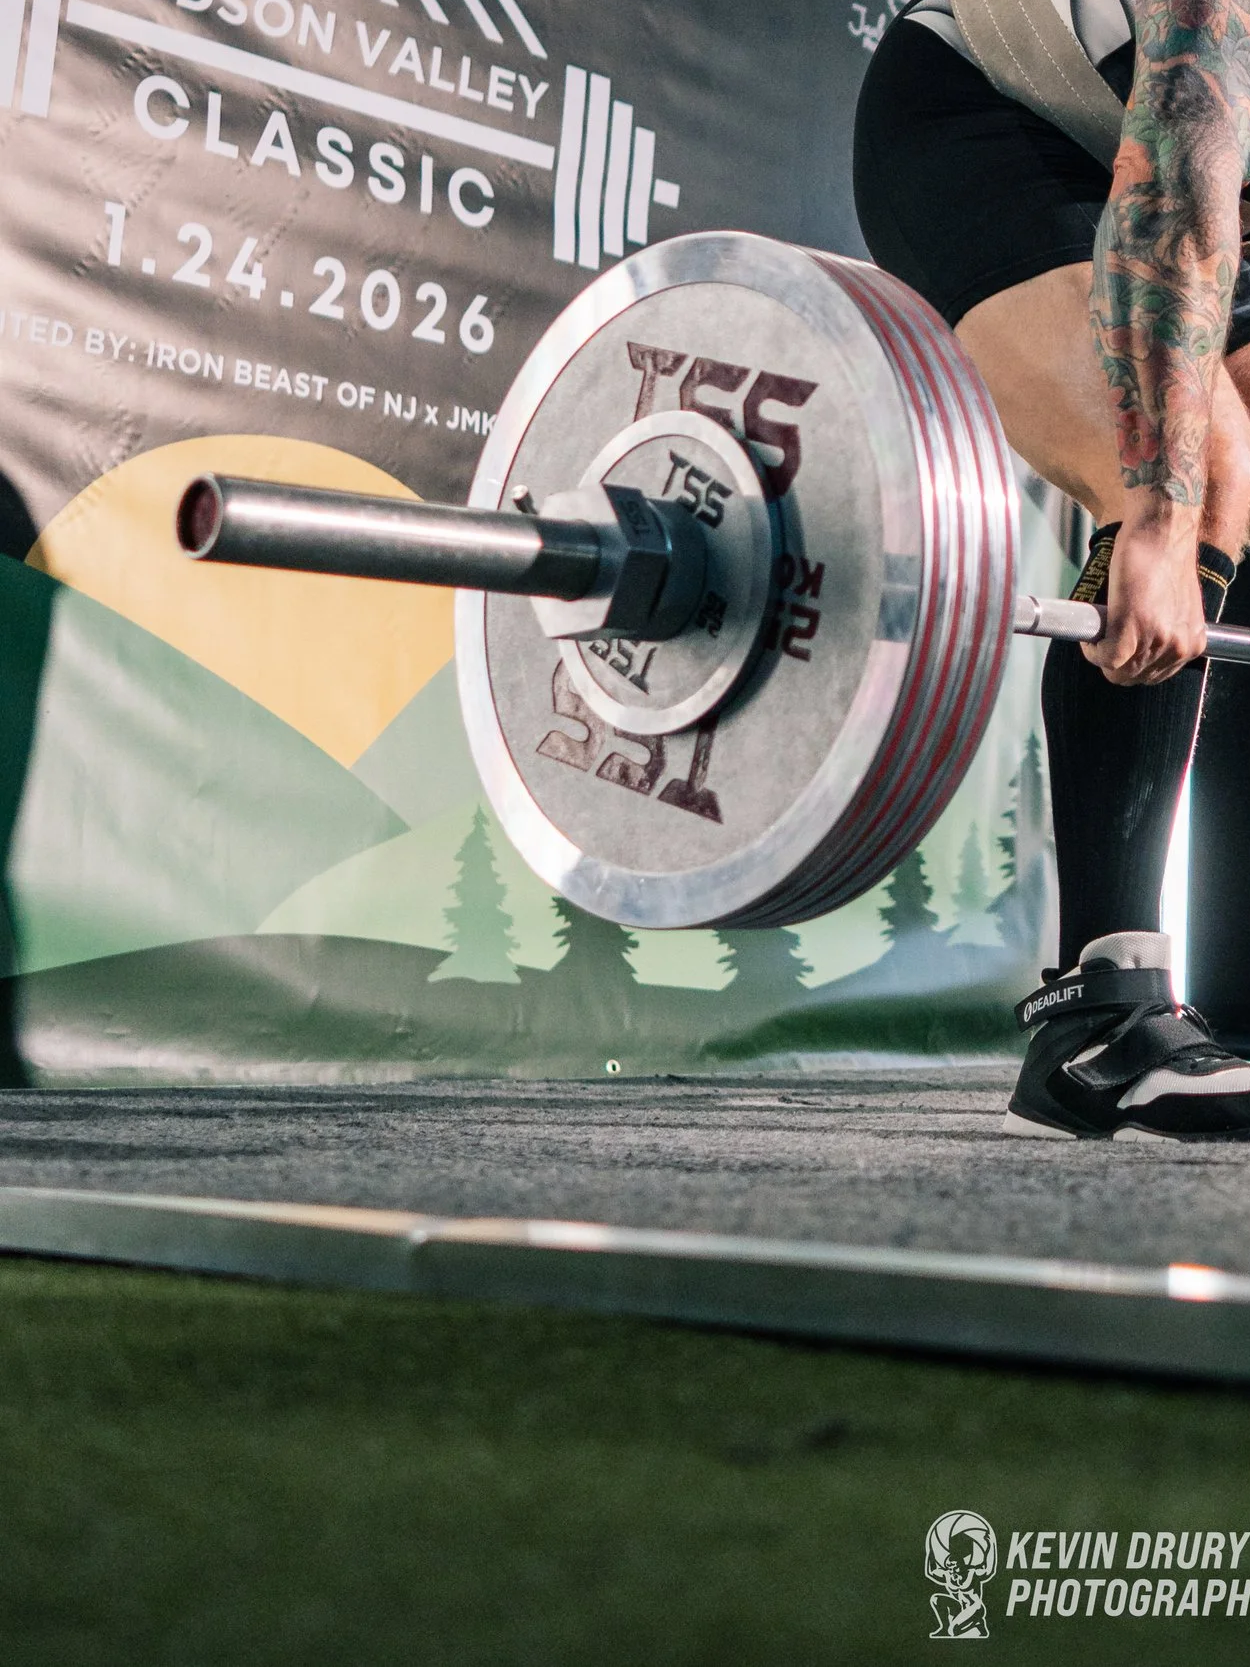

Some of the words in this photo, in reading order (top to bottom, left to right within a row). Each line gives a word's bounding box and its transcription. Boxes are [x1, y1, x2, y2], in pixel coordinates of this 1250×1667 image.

[356, 20, 549, 119] VALLEY
[133, 74, 495, 229] CLASSIC
[104, 201, 495, 354] 1.24.2026
[85, 327, 136, 362] BY:
[146, 340, 225, 381] IRON
[234, 358, 329, 401] BEAST
[337, 381, 376, 410] OF
[383, 390, 417, 421] NJ
[669, 449, 734, 530] TSS
[1032, 984, 1085, 1014] DEADLIFT
